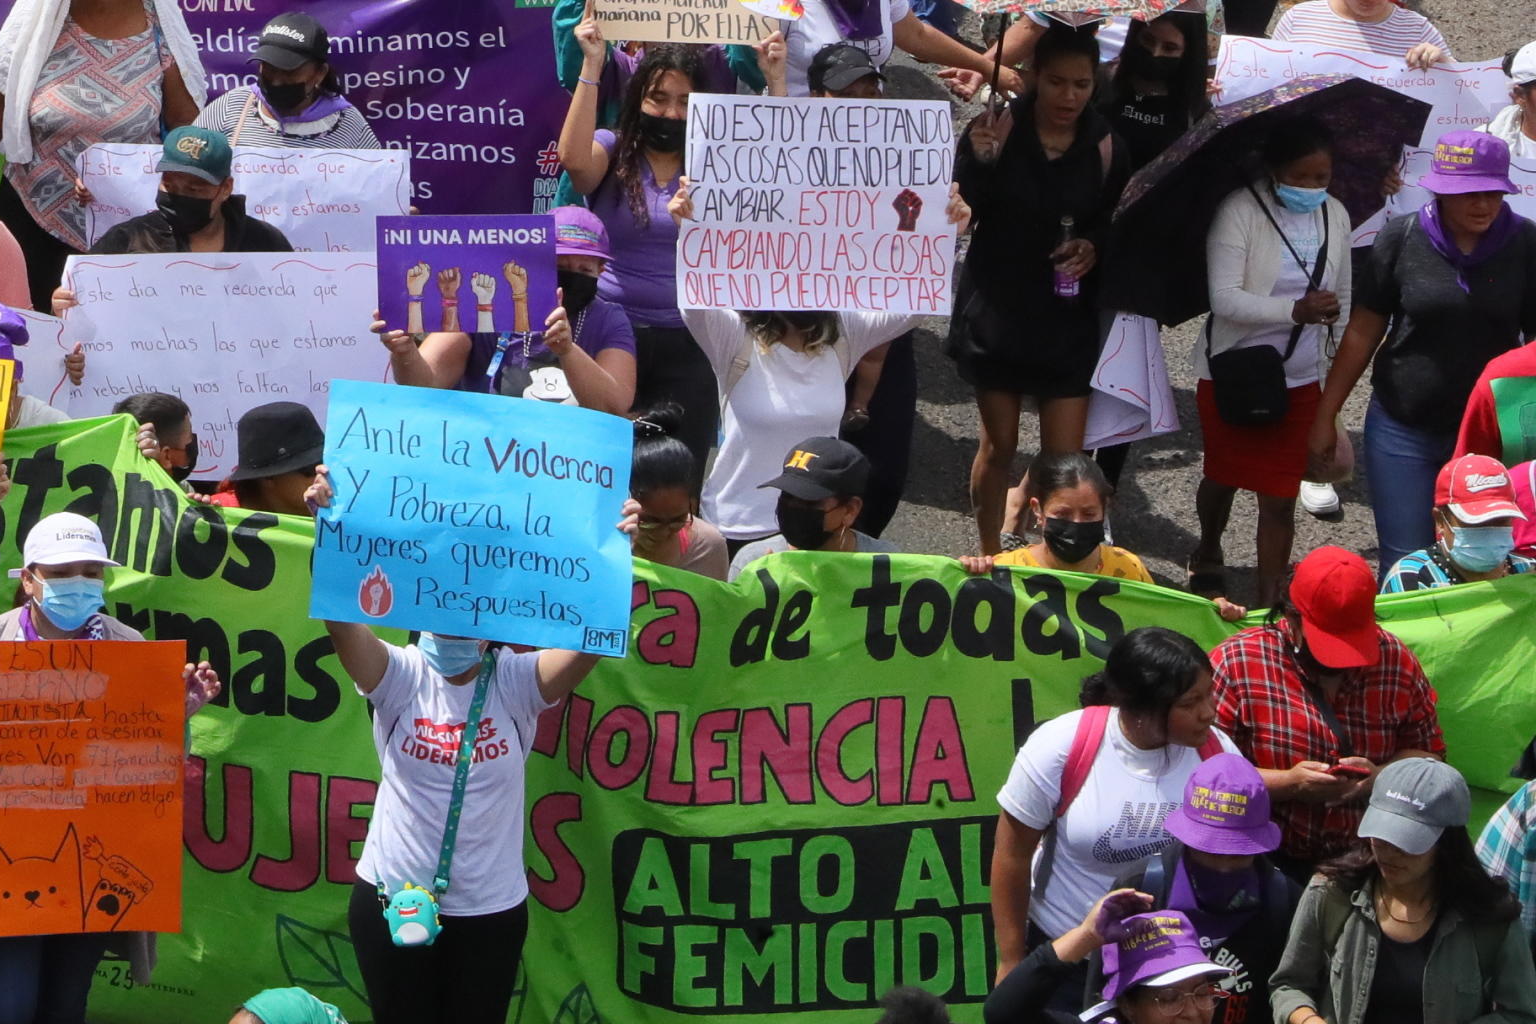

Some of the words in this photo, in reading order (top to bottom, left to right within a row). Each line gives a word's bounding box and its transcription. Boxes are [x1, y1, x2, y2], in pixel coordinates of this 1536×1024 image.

[479, 26, 507, 49] el
[593, 7, 661, 22] mañana
[666, 11, 710, 39] POR
[454, 65, 471, 90] y
[365, 98, 526, 127] Soberanía
[690, 104, 727, 141] NO
[732, 104, 811, 142] ESTOY
[818, 106, 951, 144] ACEPTANDO
[1121, 105, 1164, 125] Angel
[316, 162, 345, 182] que
[689, 144, 731, 183] LAS
[734, 145, 803, 185] COSAS
[885, 148, 952, 186] PUEDO
[254, 203, 280, 216] que
[291, 188, 361, 216] estamos
[799, 190, 881, 230] ESTOY
[384, 228, 412, 245] ¡NI
[418, 229, 463, 245] UNA
[467, 227, 547, 245] MENOS!
[682, 227, 812, 271] CAMBIANDO
[821, 231, 867, 272] LAS
[873, 233, 948, 276] COSAS
[179, 285, 207, 297] me
[223, 273, 296, 297] recuerda
[313, 285, 340, 304] que
[770, 272, 839, 308] PUEDO
[844, 275, 946, 312] ACEPTAR
[130, 326, 198, 352] muchas
[213, 322, 236, 352] las
[250, 337, 279, 358] que
[294, 320, 356, 350] estamos
[194, 382, 220, 394] nos
[309, 370, 328, 394] las
[337, 407, 421, 459] Ante
[442, 420, 472, 467] la
[484, 437, 613, 489] Violencia
[387, 475, 510, 532] Pobreza,
[524, 493, 554, 538] la
[317, 517, 428, 566] Mujeres
[451, 542, 591, 585] queremos
[415, 576, 583, 627] Respuestas
[729, 568, 814, 669] de
[851, 553, 1125, 661] todas
[587, 630, 614, 649] 8M
[9, 643, 44, 670] ES
[49, 643, 93, 671] UN
[103, 703, 162, 723] hasta
[57, 720, 78, 740] de
[86, 726, 163, 740] asesinar
[95, 786, 134, 803] hacen
[623, 835, 857, 920] ALTO
